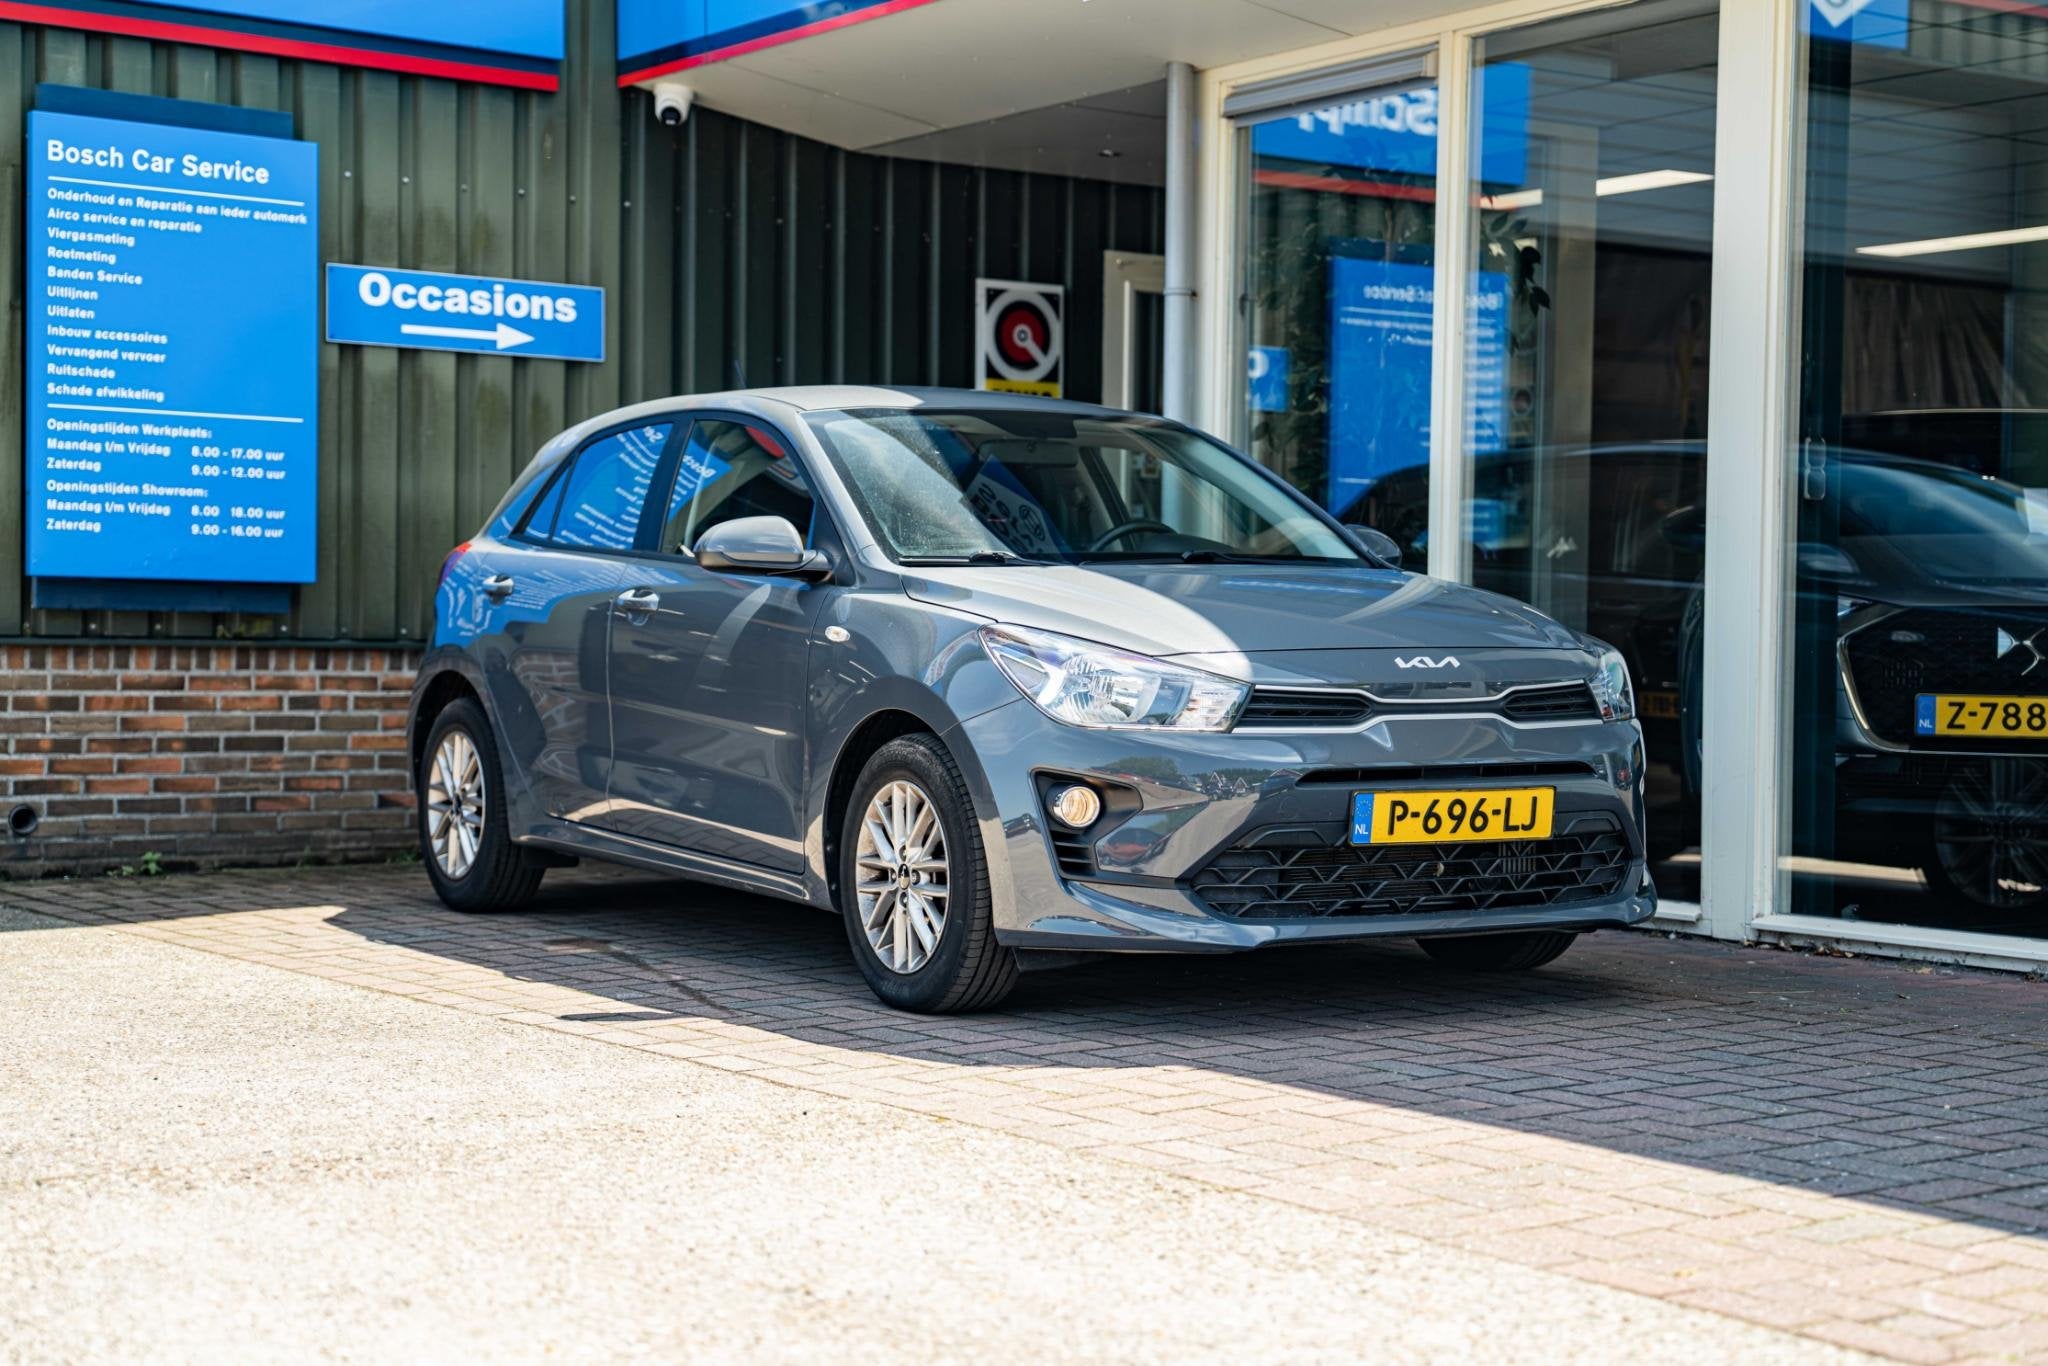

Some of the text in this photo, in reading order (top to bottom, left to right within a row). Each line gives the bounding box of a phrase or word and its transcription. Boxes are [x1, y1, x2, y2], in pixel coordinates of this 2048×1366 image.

[47, 139, 269, 184] Bosch Car Service
[48, 188, 307, 224] Onderhoud en Reparatie aan ieder automerk
[48, 208, 202, 233] Airco service en reparatie
[48, 228, 135, 247] Viergasmeting
[48, 247, 116, 264] Roetmeting
[48, 266, 143, 285] Banden Service
[48, 286, 98, 301] Uitlijnen
[358, 272, 578, 322] Occasions
[48, 305, 95, 319] Uitlaten
[48, 325, 168, 344] Inbouw accessoires
[47, 344, 166, 362] Vervangend vervoer
[47, 364, 115, 379] Ruitschade
[47, 383, 164, 403] Schade afwikkeling
[47, 418, 212, 439] Openingstijden Werkplaats:
[47, 438, 102, 453] Maandag
[105, 442, 125, 454] t/m
[128, 443, 171, 457] Vrijdag
[191, 446, 220, 458] 8.00
[230, 447, 263, 460] 17.00
[266, 450, 285, 461] uur
[47, 458, 102, 473] Zaterdag
[191, 465, 220, 477] 9.00
[231, 467, 263, 479] 12.00
[266, 469, 286, 480] uur
[47, 480, 208, 499] Openingstijden Showroom:
[47, 500, 102, 515] Maandag
[105, 503, 125, 514] t/m
[128, 503, 171, 516] Vrijdag
[191, 505, 220, 517] 8.00
[266, 510, 285, 520] uur
[47, 518, 102, 533] Zaterdag
[191, 524, 220, 535] 9.00
[265, 527, 284, 538] uur
[1394, 656, 1461, 668] KIA
[1919, 701, 2047, 731] NL Z-788
[1355, 797, 1537, 836] NL P-696-LJ
